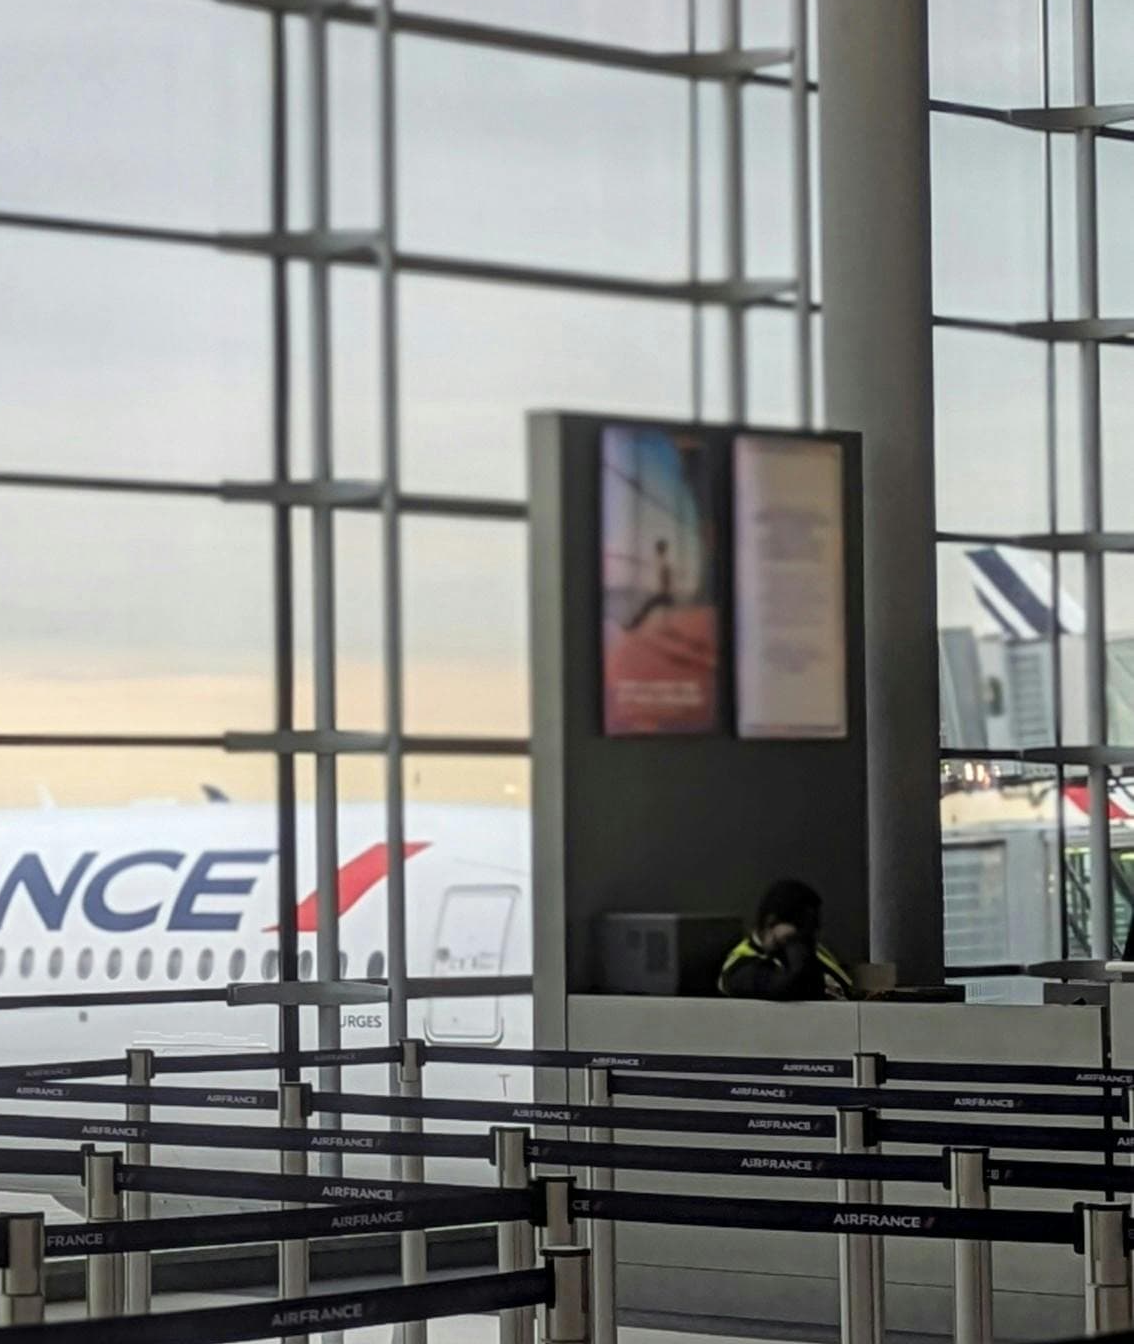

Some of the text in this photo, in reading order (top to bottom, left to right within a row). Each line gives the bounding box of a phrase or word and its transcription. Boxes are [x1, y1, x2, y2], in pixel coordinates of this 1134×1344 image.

[591, 1057, 639, 1067] AIRFRANCE
[783, 1063, 834, 1073] AIRFRANCE
[16, 1086, 64, 1097] AIRFRANCE
[730, 1086, 786, 1099] AIRFRANCE
[206, 1094, 258, 1105] AIRFRANCE
[953, 1097, 1014, 1109] AIRFRANCE
[512, 1108, 571, 1121] AIRFRANCE
[81, 1125, 139, 1137] AIRFRANCE
[748, 1118, 811, 1132] AIRFRANCE
[311, 1136, 374, 1149] AIRFRANCE
[741, 1157, 812, 1171] AIRFRANCE
[321, 1185, 394, 1202] AIRFRANCE
[330, 1210, 405, 1229] AIRFRANCE
[833, 1212, 921, 1229] AIRFRANCE
[271, 1303, 363, 1328] AIRFRANCE
